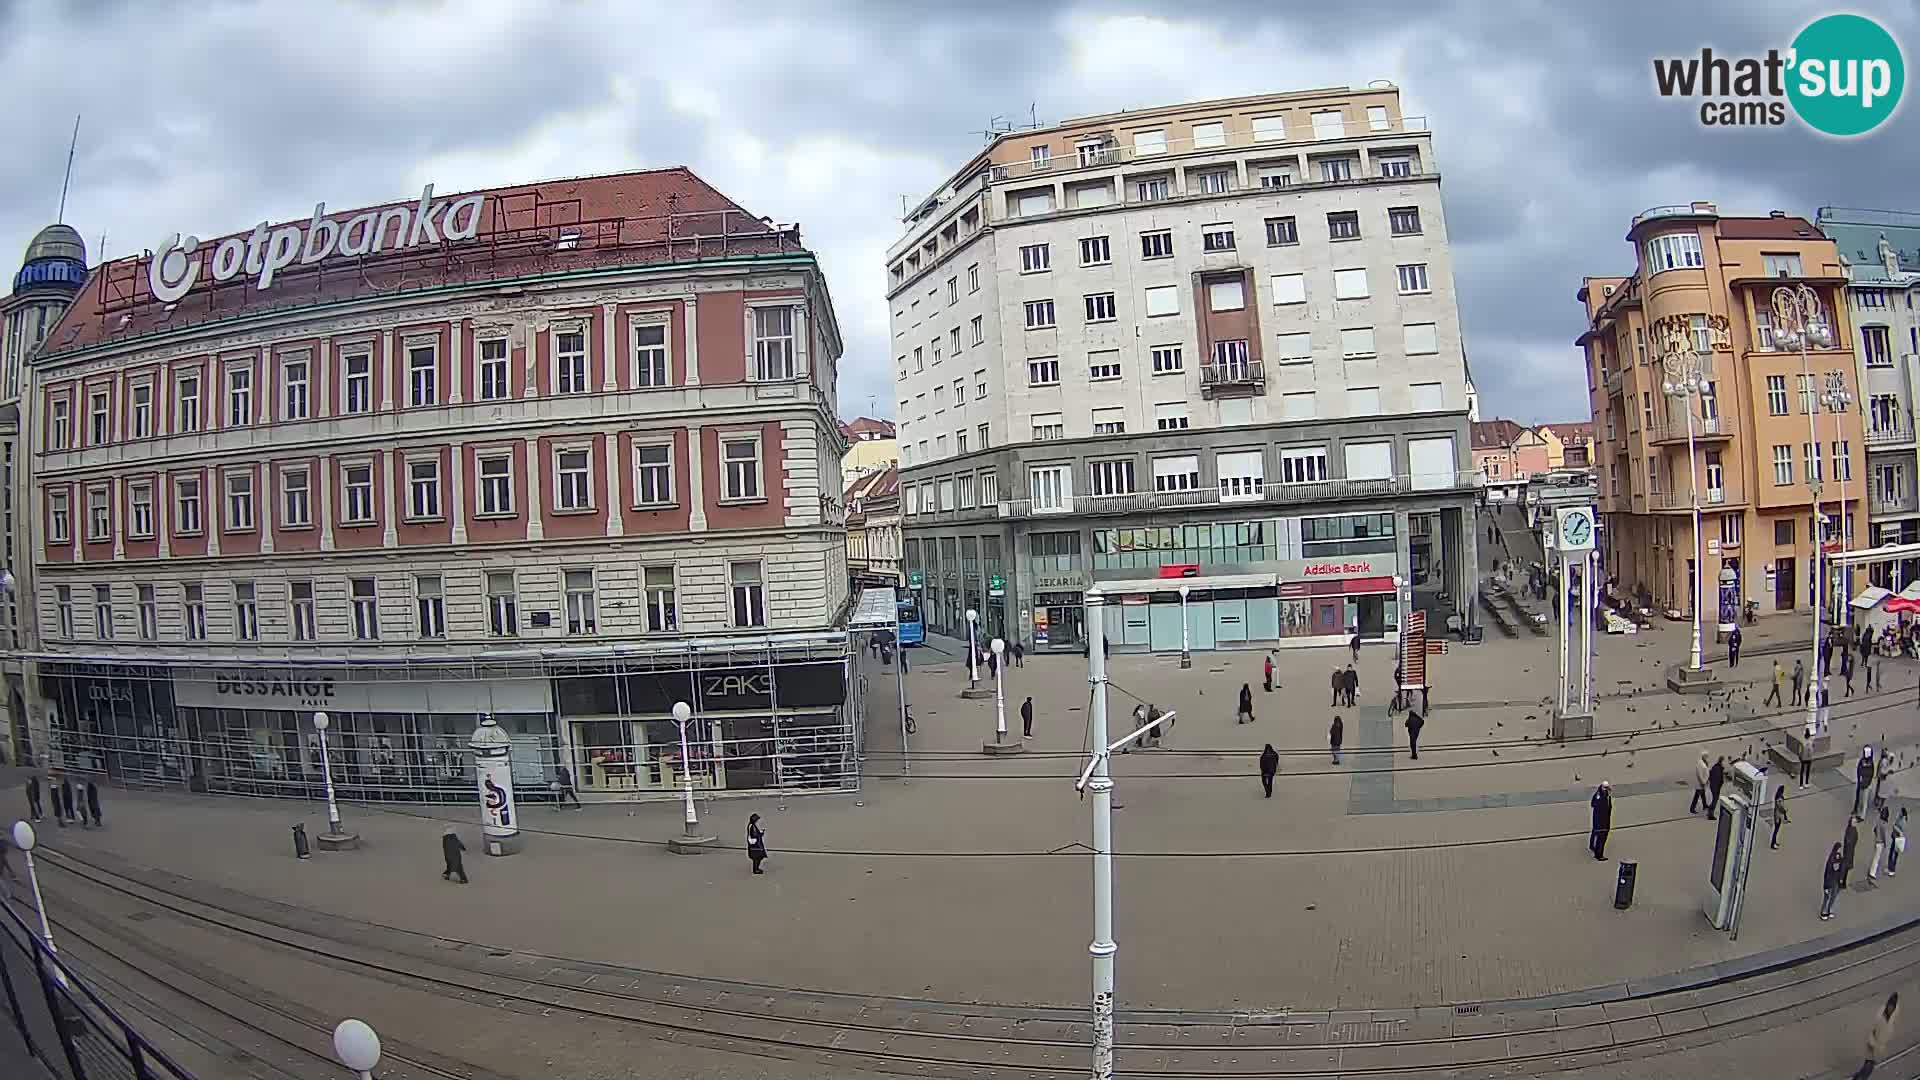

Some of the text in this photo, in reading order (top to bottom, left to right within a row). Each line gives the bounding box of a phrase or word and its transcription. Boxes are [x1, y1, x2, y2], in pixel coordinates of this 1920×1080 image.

[1304, 561, 1371, 576] Addiko Bank
[216, 674, 335, 697] DESSANGE
[705, 674, 774, 696] ZAKS
